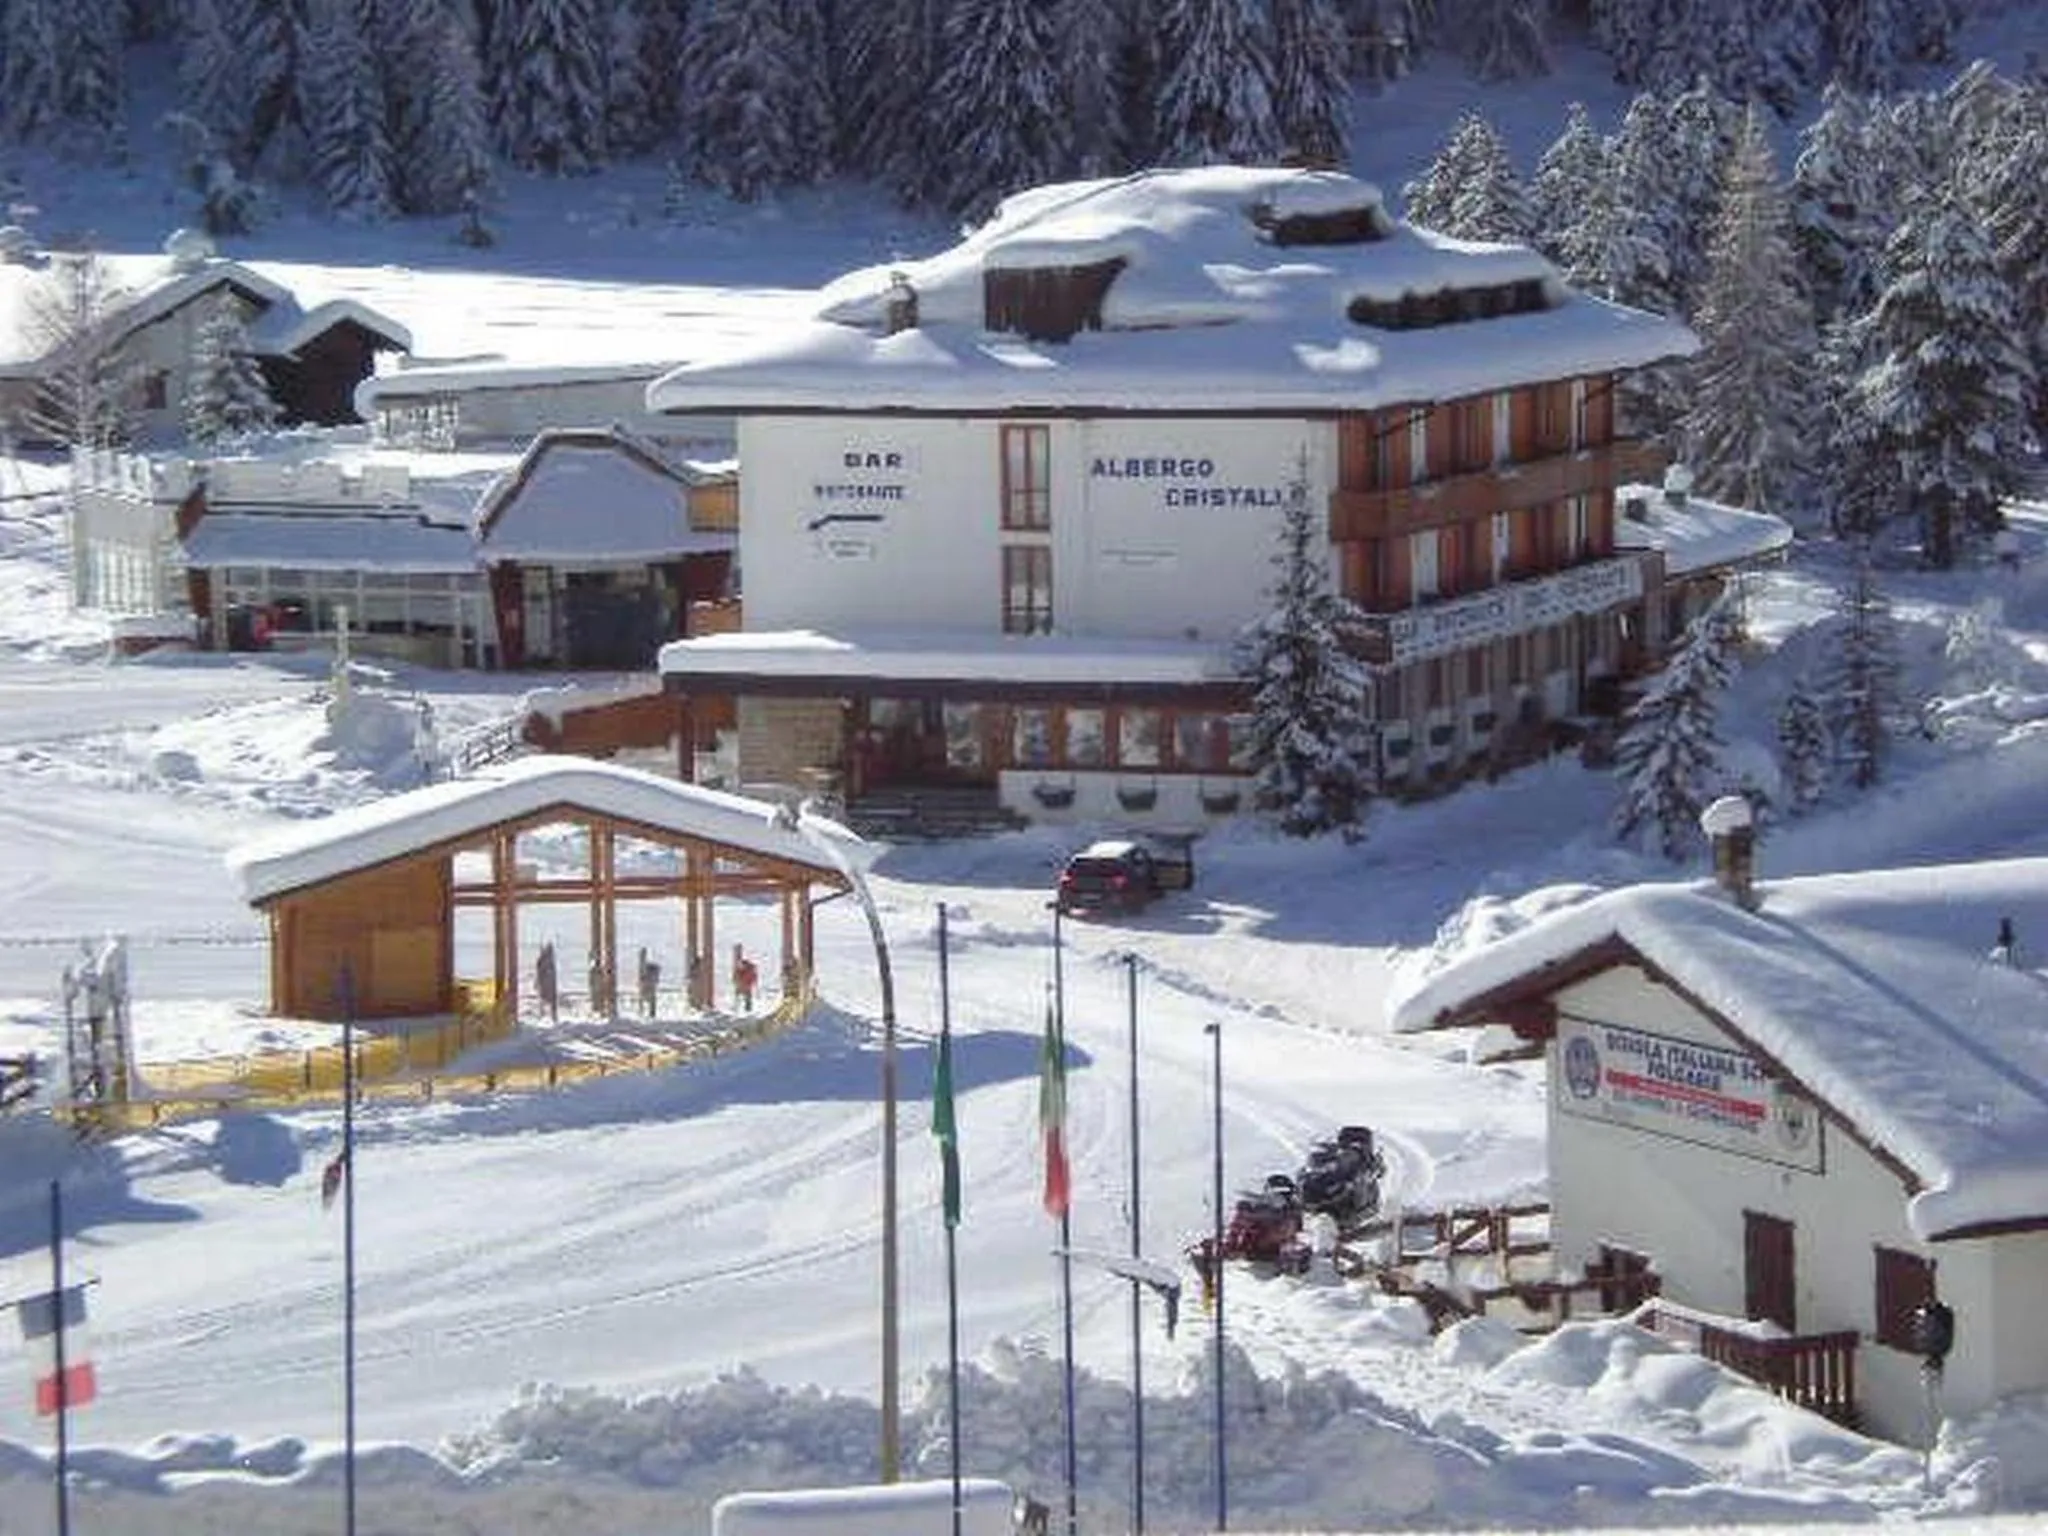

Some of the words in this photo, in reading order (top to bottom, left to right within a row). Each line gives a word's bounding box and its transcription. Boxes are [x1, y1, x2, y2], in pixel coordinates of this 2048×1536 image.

[845, 453, 902, 468] BAR
[1091, 458, 1215, 478] ALBERGO
[1166, 487, 1304, 508] CRISTALL
